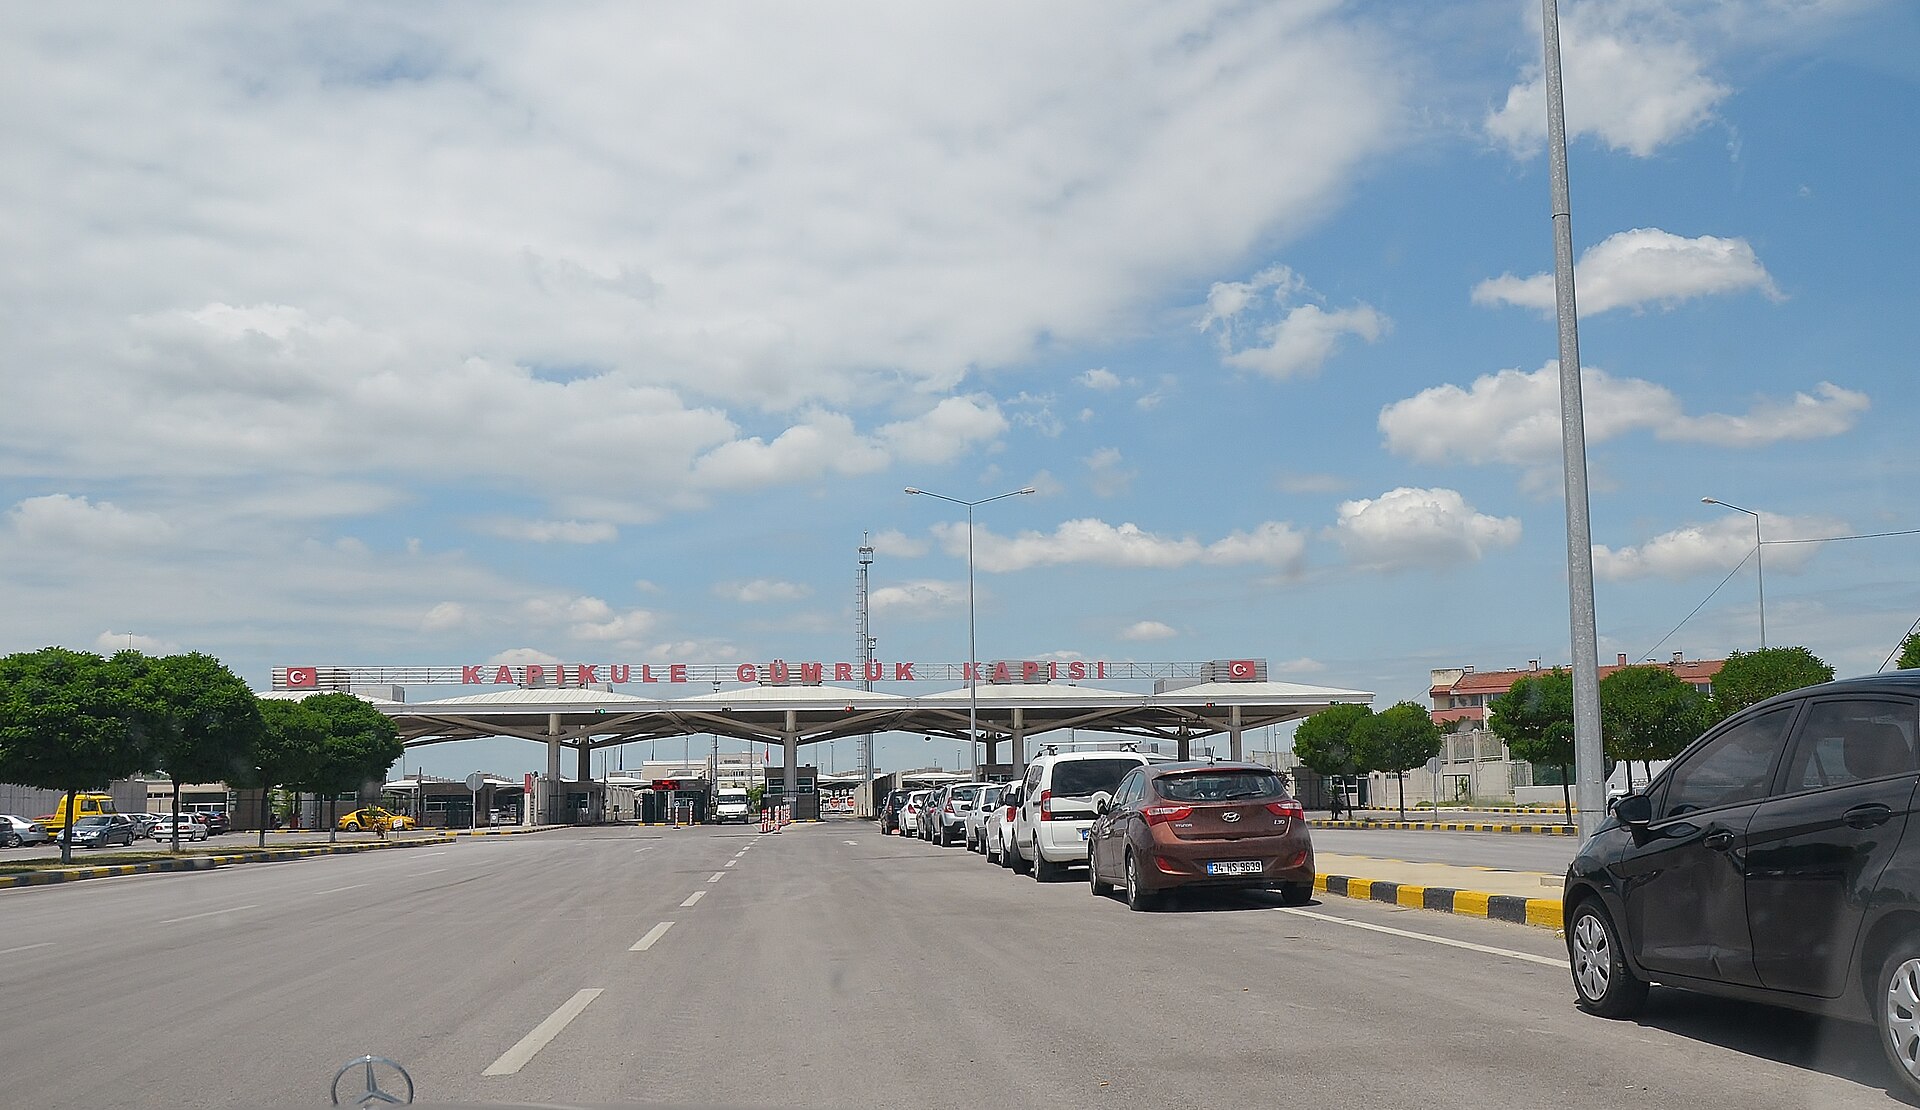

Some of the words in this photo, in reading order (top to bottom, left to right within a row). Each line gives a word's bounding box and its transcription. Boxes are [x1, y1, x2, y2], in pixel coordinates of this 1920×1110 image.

[462, 664, 687, 684] KAPIKULE
[737, 659, 915, 683] GÜMRÜK
[963, 661, 1105, 681] KAPISI
[1213, 863, 1224, 873] 34
[1226, 862, 1238, 872] HS
[1240, 862, 1261, 872] 9639
